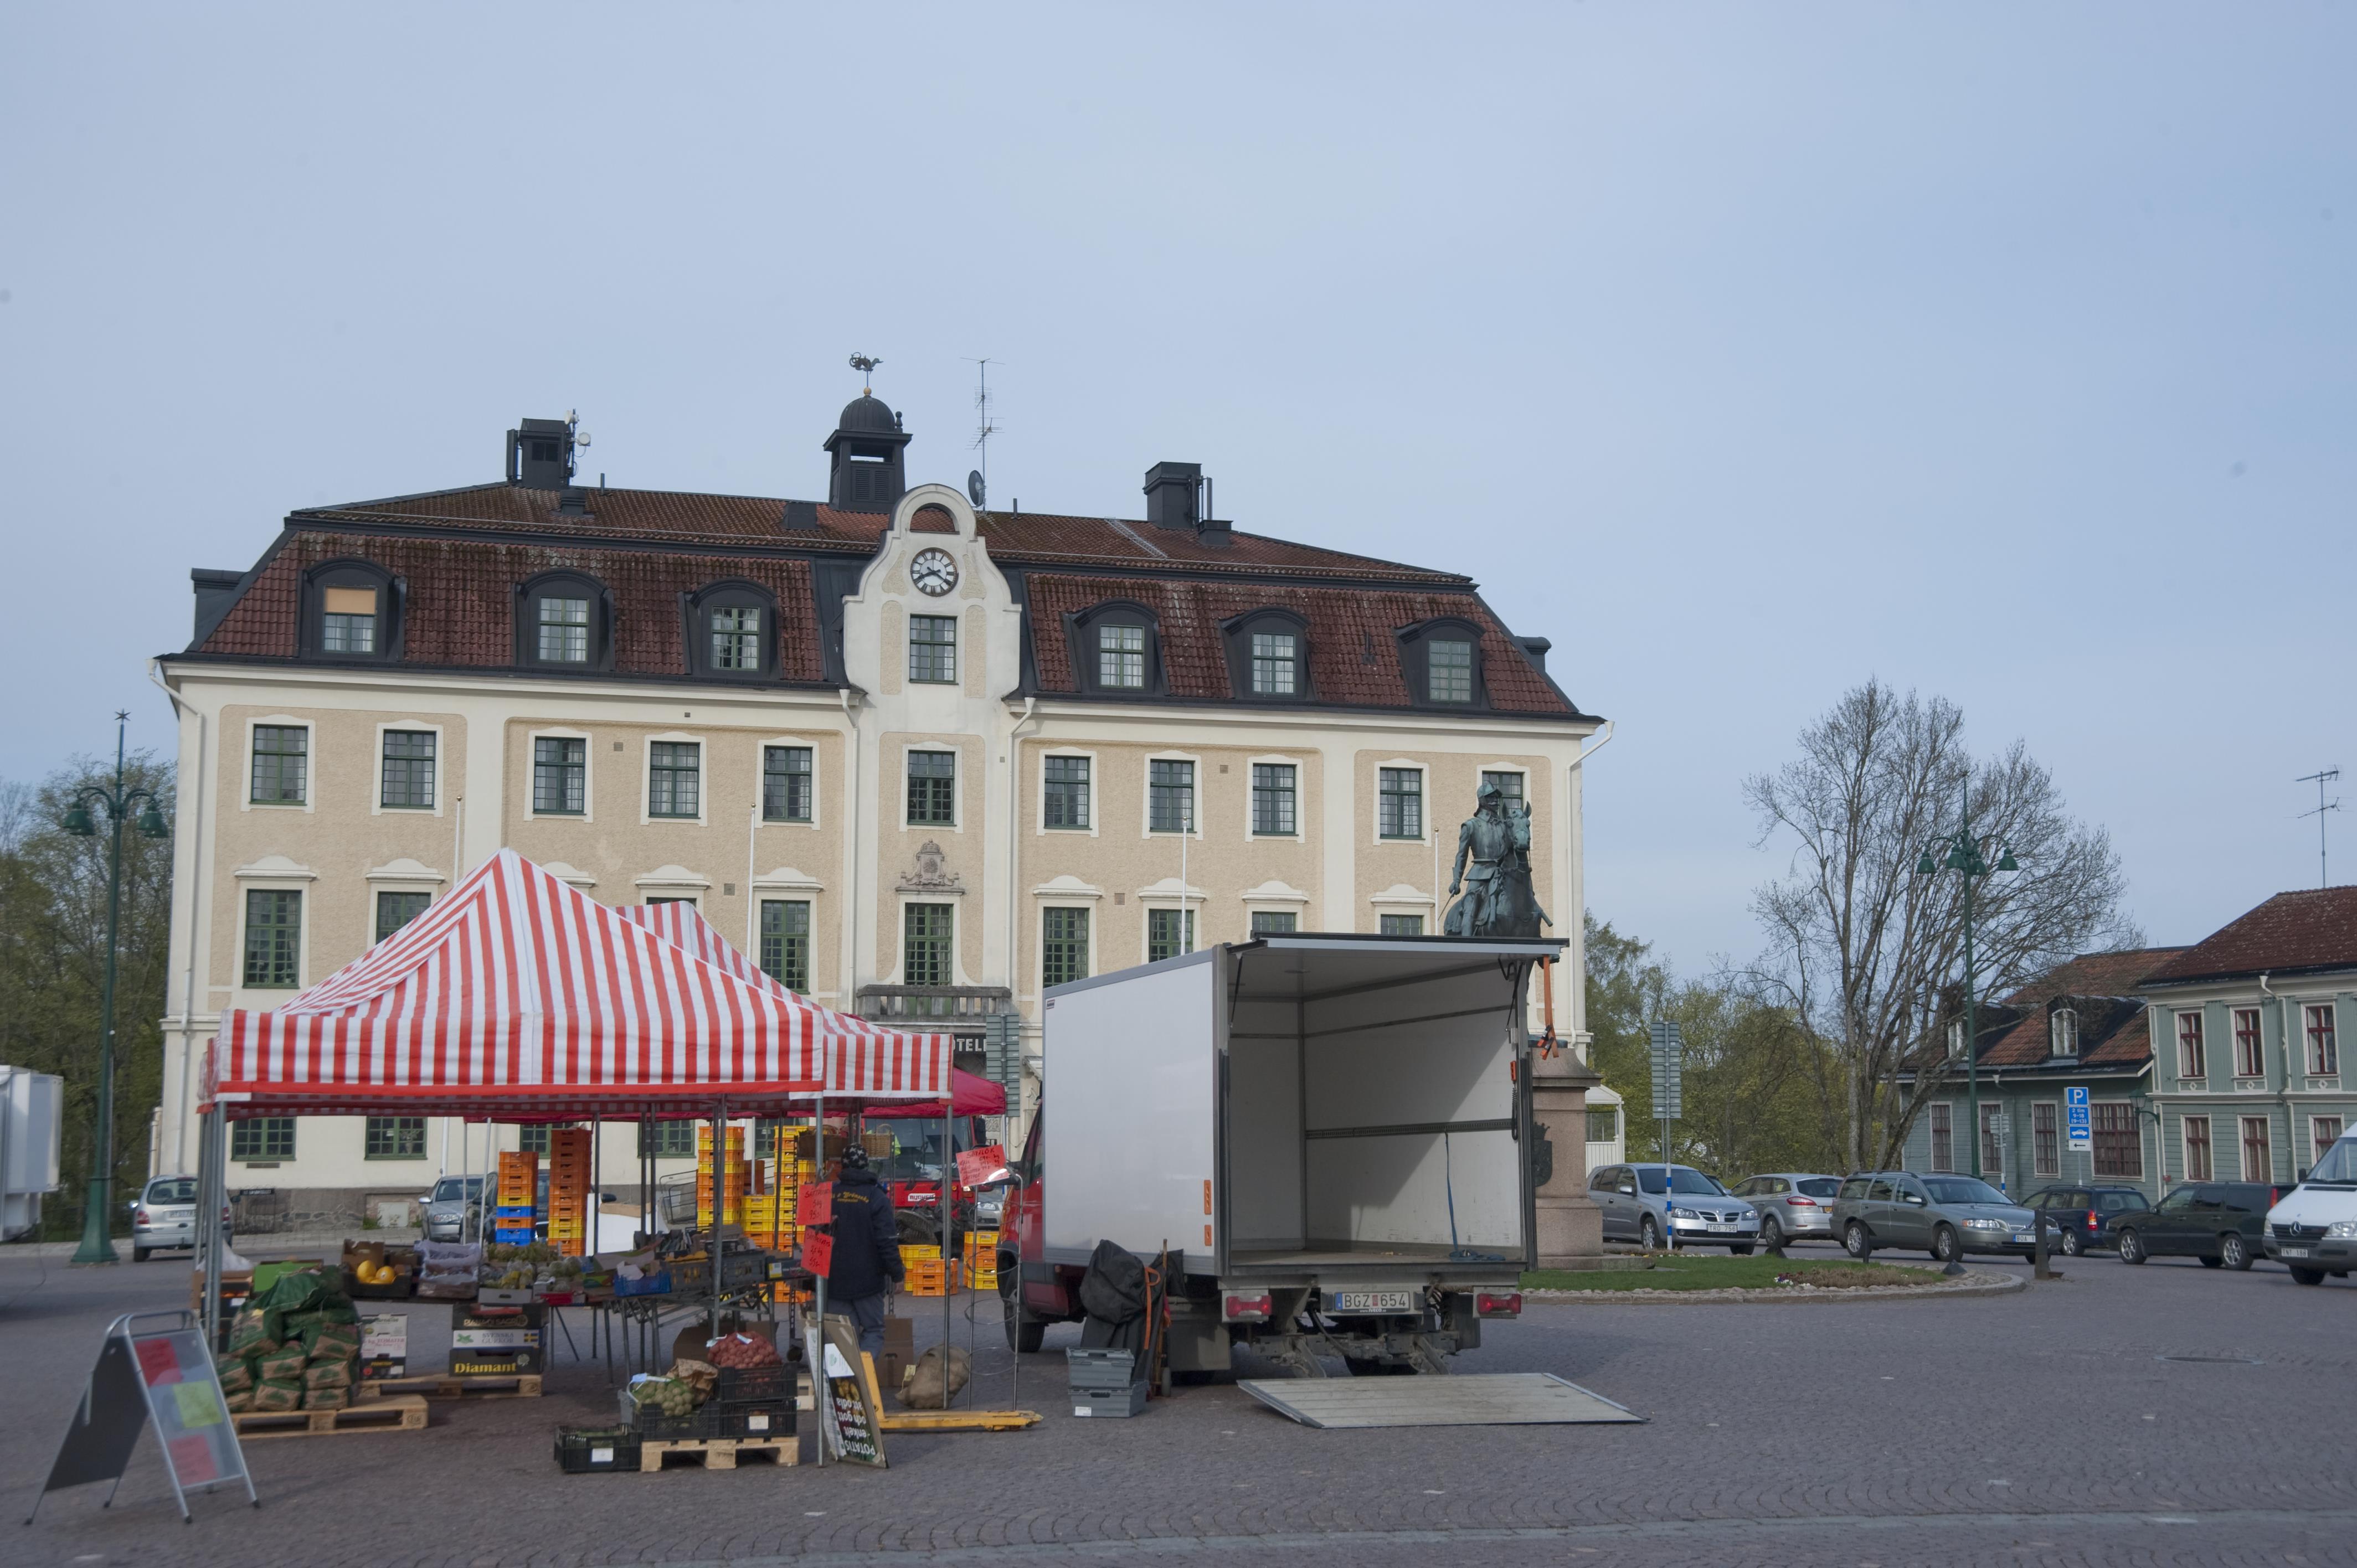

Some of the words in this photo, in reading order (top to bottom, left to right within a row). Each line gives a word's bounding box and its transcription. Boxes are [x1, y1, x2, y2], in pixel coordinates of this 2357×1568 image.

[2073, 1089, 2083, 1104] P
[1345, 1294, 1370, 1307] BGZ
[1380, 1294, 1406, 1307] 654
[455, 1362, 517, 1374] Diamant
[836, 1397, 852, 1410] odla
[853, 1401, 863, 1410] att
[837, 1411, 853, 1422] gott
[853, 1415, 866, 1426] och
[843, 1426, 867, 1439] enkelt
[844, 1440, 876, 1455] POTATIS
